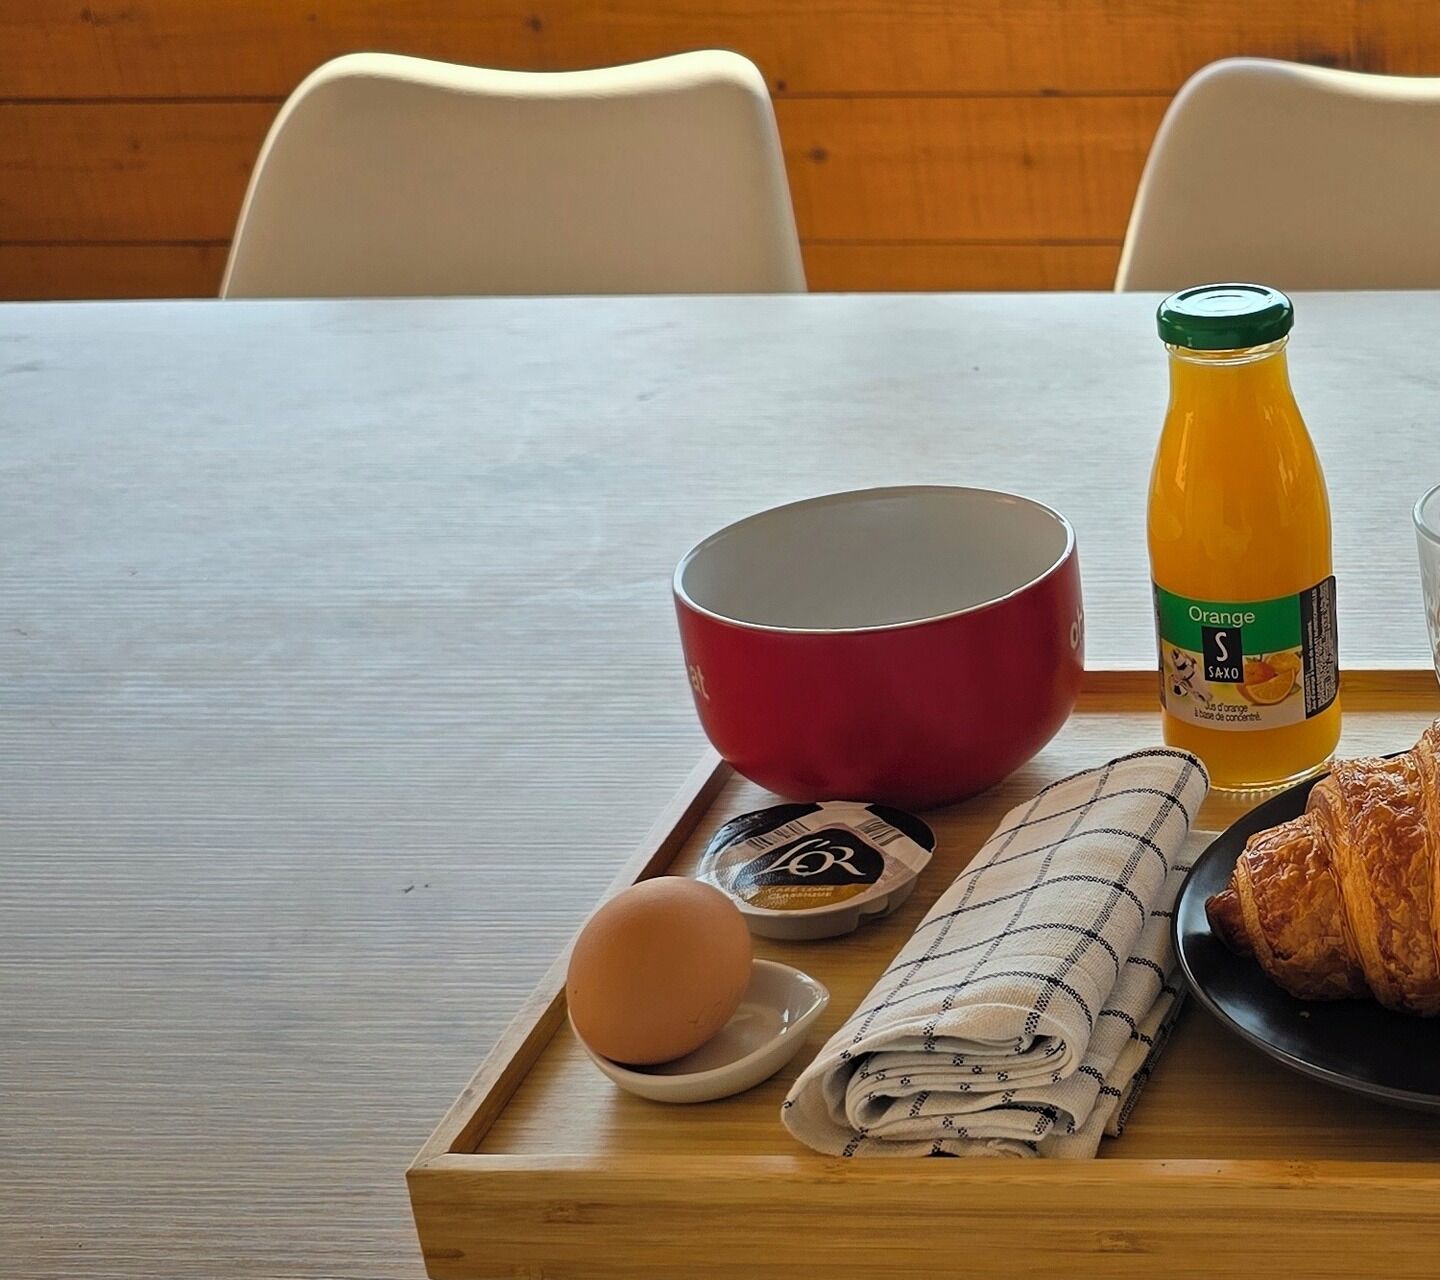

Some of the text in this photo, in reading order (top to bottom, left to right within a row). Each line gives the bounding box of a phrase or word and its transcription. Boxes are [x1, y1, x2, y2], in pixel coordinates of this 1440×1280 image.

[1188, 605, 1256, 628] Orange
[1214, 631, 1228, 662] S
[1208, 665, 1239, 680] SAXO
